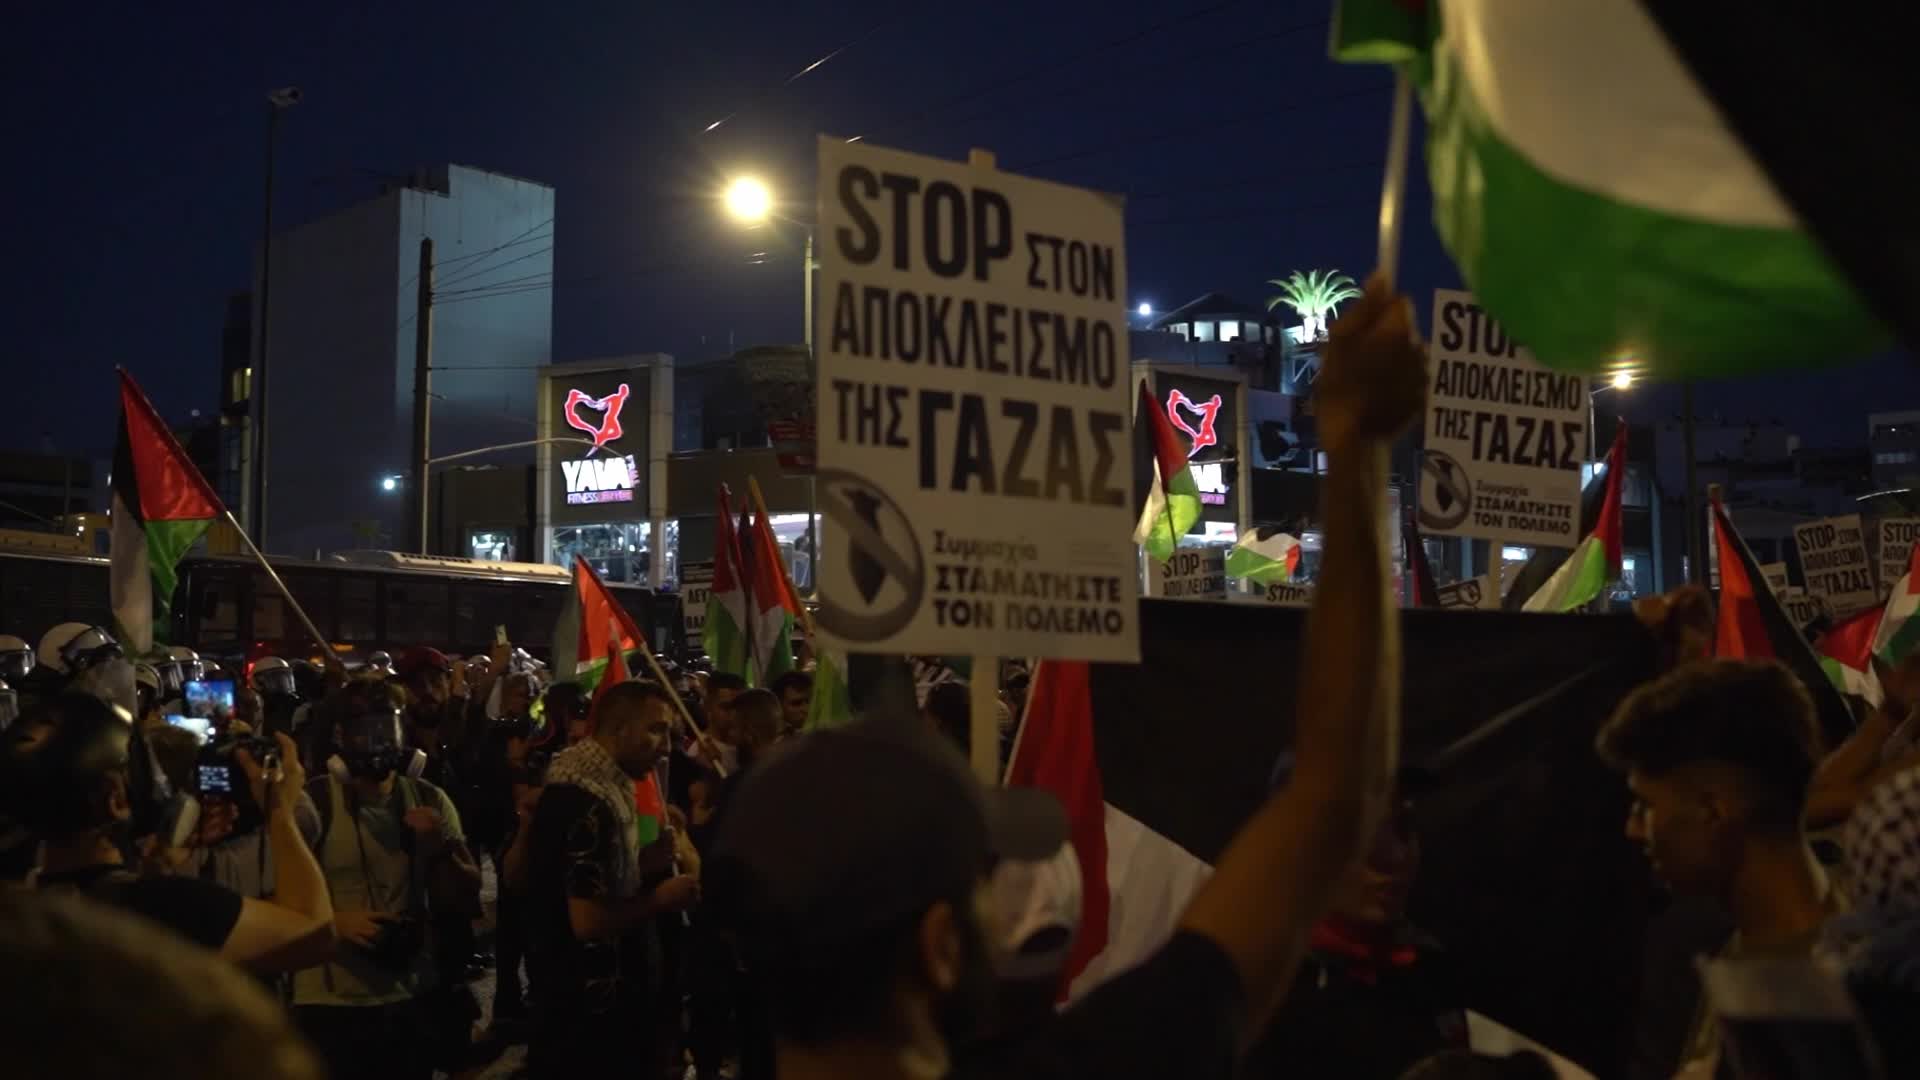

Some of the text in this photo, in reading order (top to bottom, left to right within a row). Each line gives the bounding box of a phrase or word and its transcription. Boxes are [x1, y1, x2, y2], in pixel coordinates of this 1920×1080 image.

[837, 164, 1114, 302] STOP ΣΤΟΝ
[831, 282, 1116, 390] ΑΠΟΚΛΕΙΣΜΟ
[1441, 302, 1516, 358] STO
[1434, 359, 1583, 411] ΑΠΟΚΛΕΙΣΜΟ
[832, 379, 1126, 507] ΤΗΣ ΓΑΖΑΣ
[1434, 406, 1583, 471] ΤΗΣ ΓΑΖΑΣ
[561, 456, 636, 493] YAVA
[1473, 511, 1504, 528] ΤΟΝ
[1798, 524, 1836, 551] STOP
[935, 564, 1122, 602] ΣΤΑΜΑΤΗΣΤΕ
[933, 598, 1125, 635] ΤΟΝ ΠΟΛΕΜΟ
